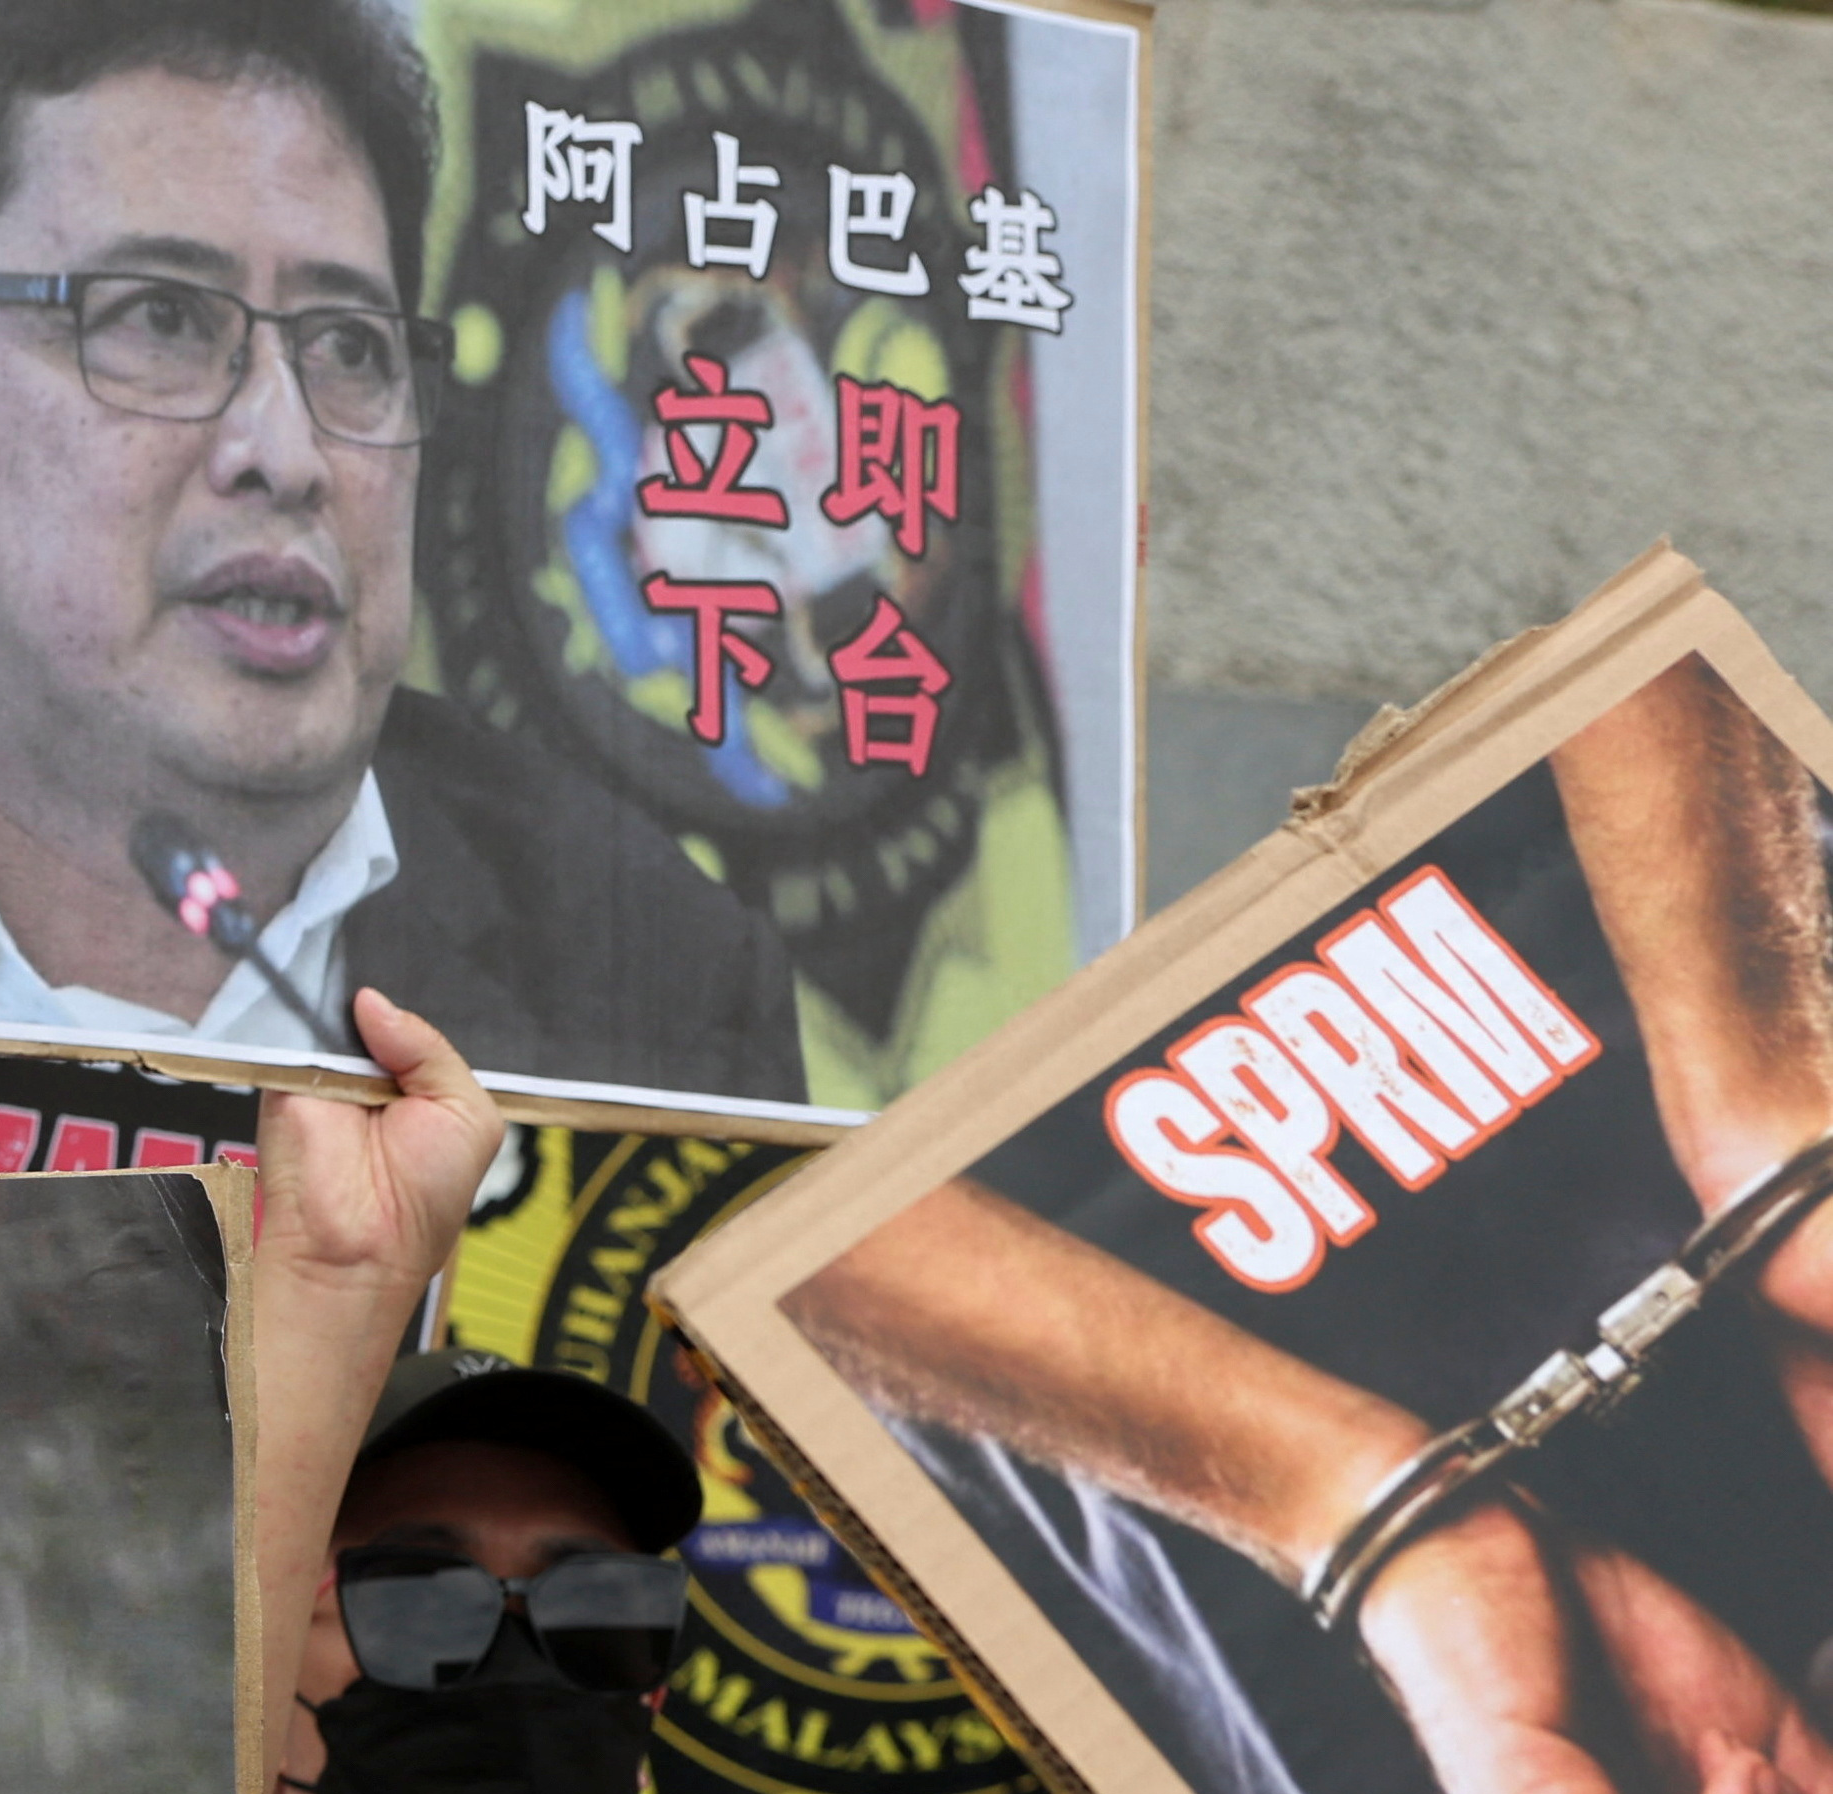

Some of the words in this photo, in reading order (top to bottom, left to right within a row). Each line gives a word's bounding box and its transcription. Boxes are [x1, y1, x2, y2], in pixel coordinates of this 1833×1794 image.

[522, 101, 1073, 336] 阿占巴基
[636, 350, 962, 559] 立即
[642, 570, 952, 777] 下台
[1103, 864, 1602, 1293] SPRM
